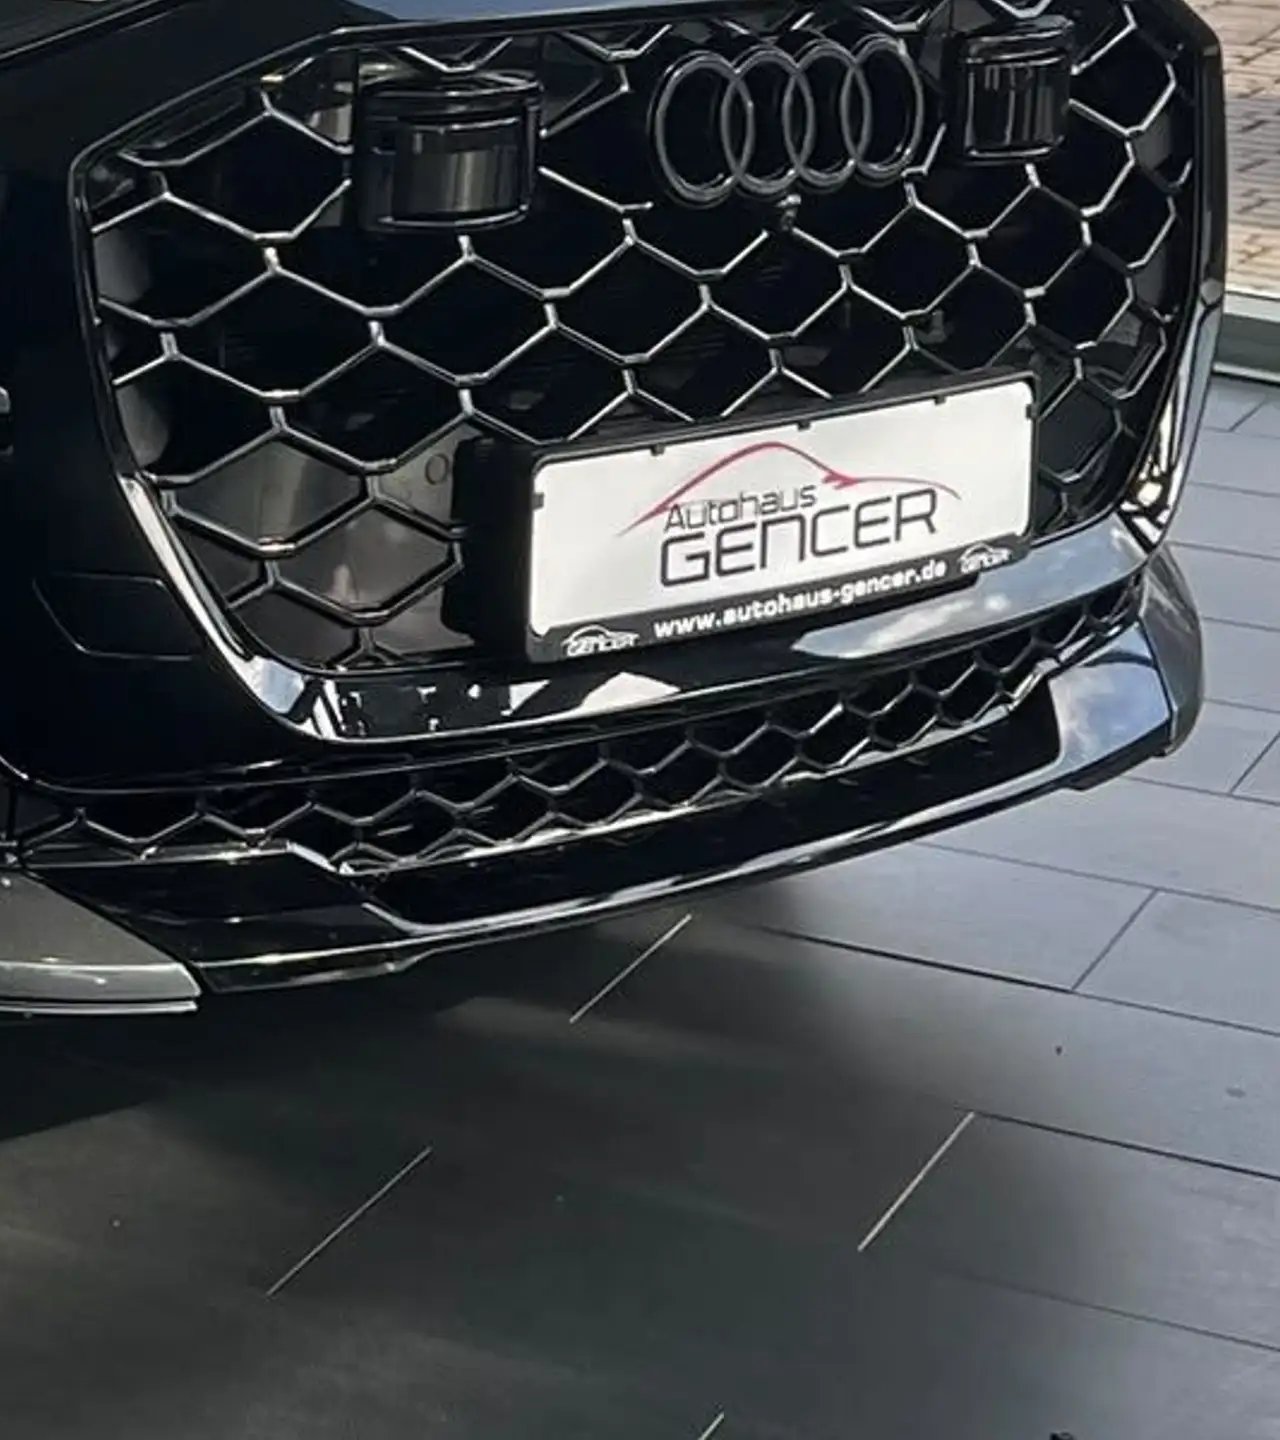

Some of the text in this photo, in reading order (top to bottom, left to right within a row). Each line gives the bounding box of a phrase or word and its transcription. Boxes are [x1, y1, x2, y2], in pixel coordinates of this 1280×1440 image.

[660, 488, 938, 587] GENCER
[663, 485, 816, 532] Autohaus
[653, 560, 947, 638] www.autohaus-gencer.de
